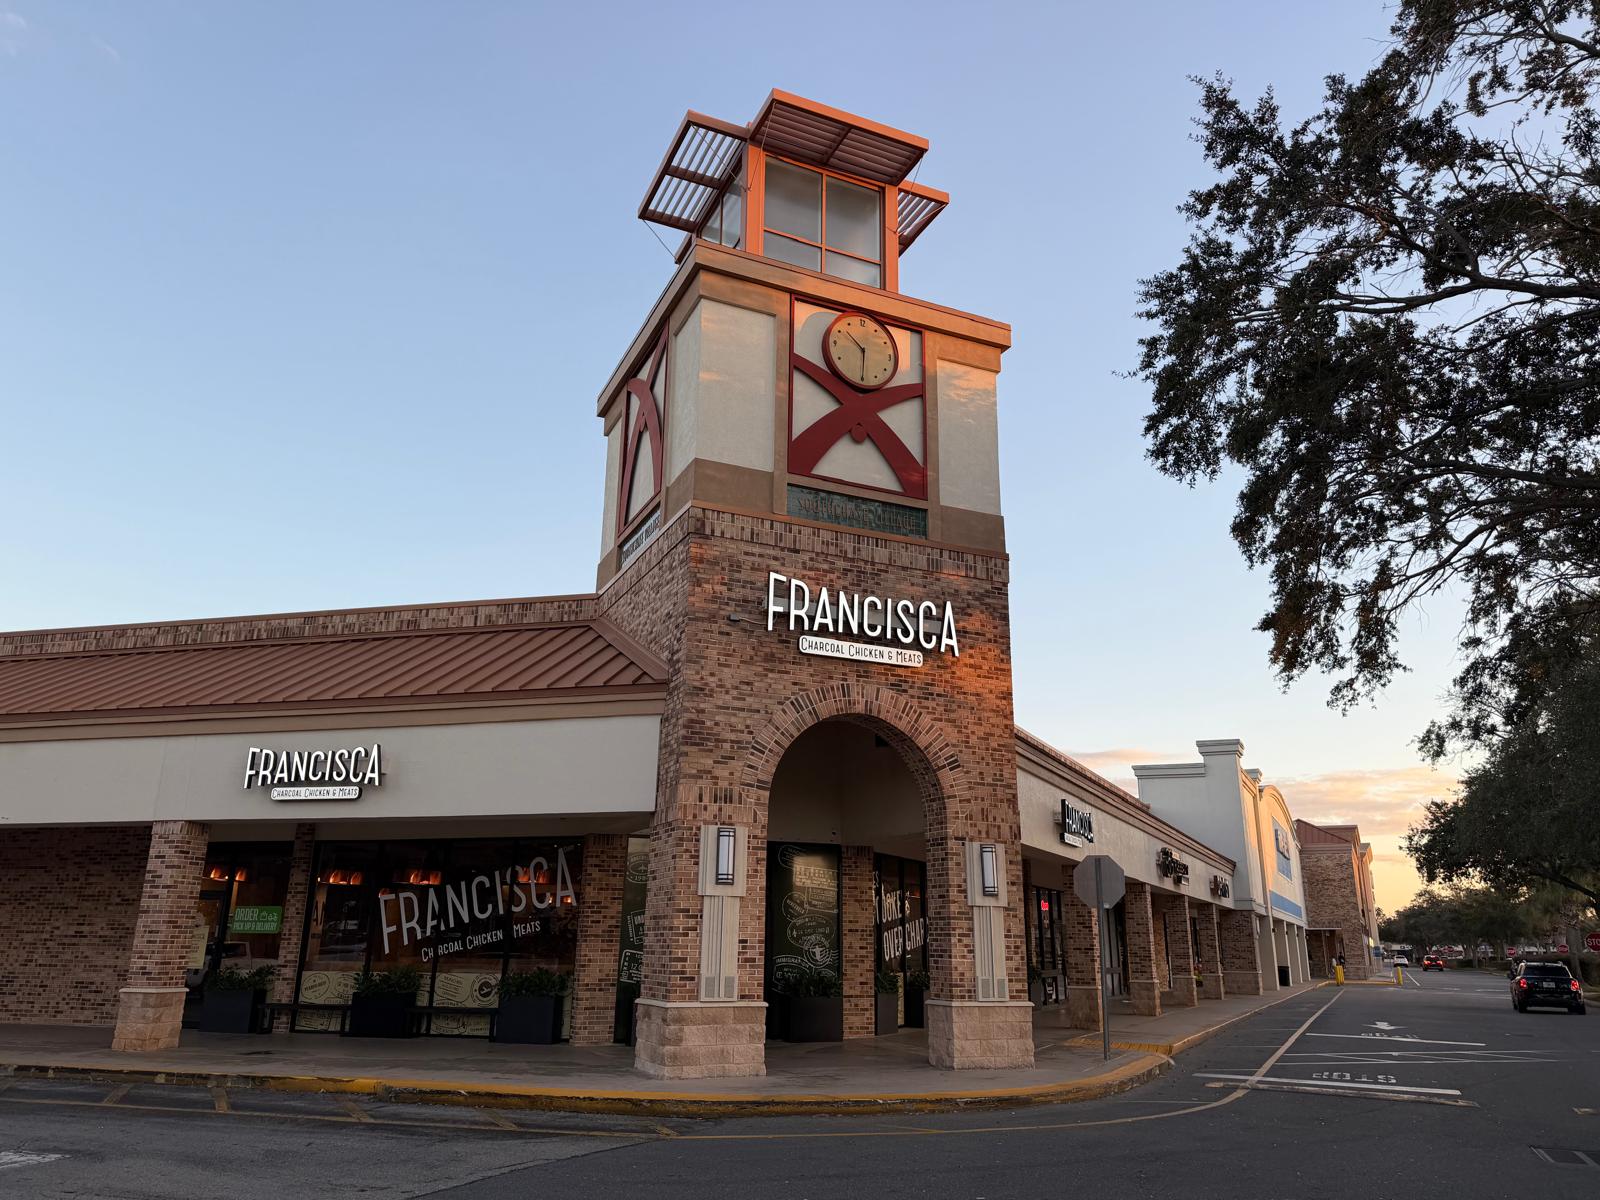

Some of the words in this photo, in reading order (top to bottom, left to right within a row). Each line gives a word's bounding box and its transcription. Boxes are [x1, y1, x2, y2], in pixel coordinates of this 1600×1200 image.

[767, 572, 960, 657] FRANCISCA
[801, 637, 845, 655] CHARCOAL
[848, 644, 884, 660] CHICKEN
[887, 650, 894, 660] &
[896, 650, 922, 665] MEATS
[244, 744, 380, 788] FRANCISCA
[272, 788, 302, 798] CHARCOAL
[304, 788, 330, 798] CHICKEN
[332, 789, 337, 797] &
[338, 788, 358, 797] MEATS
[235, 908, 258, 921] ORDER
[379, 847, 578, 954] FRANCISCA
[421, 938, 464, 962] CHRCOAL
[466, 928, 504, 950] CHICKEN
[513, 920, 542, 939] MEATS
[883, 925, 904, 962] OVER
[1312, 1072, 1397, 1084] STOP
